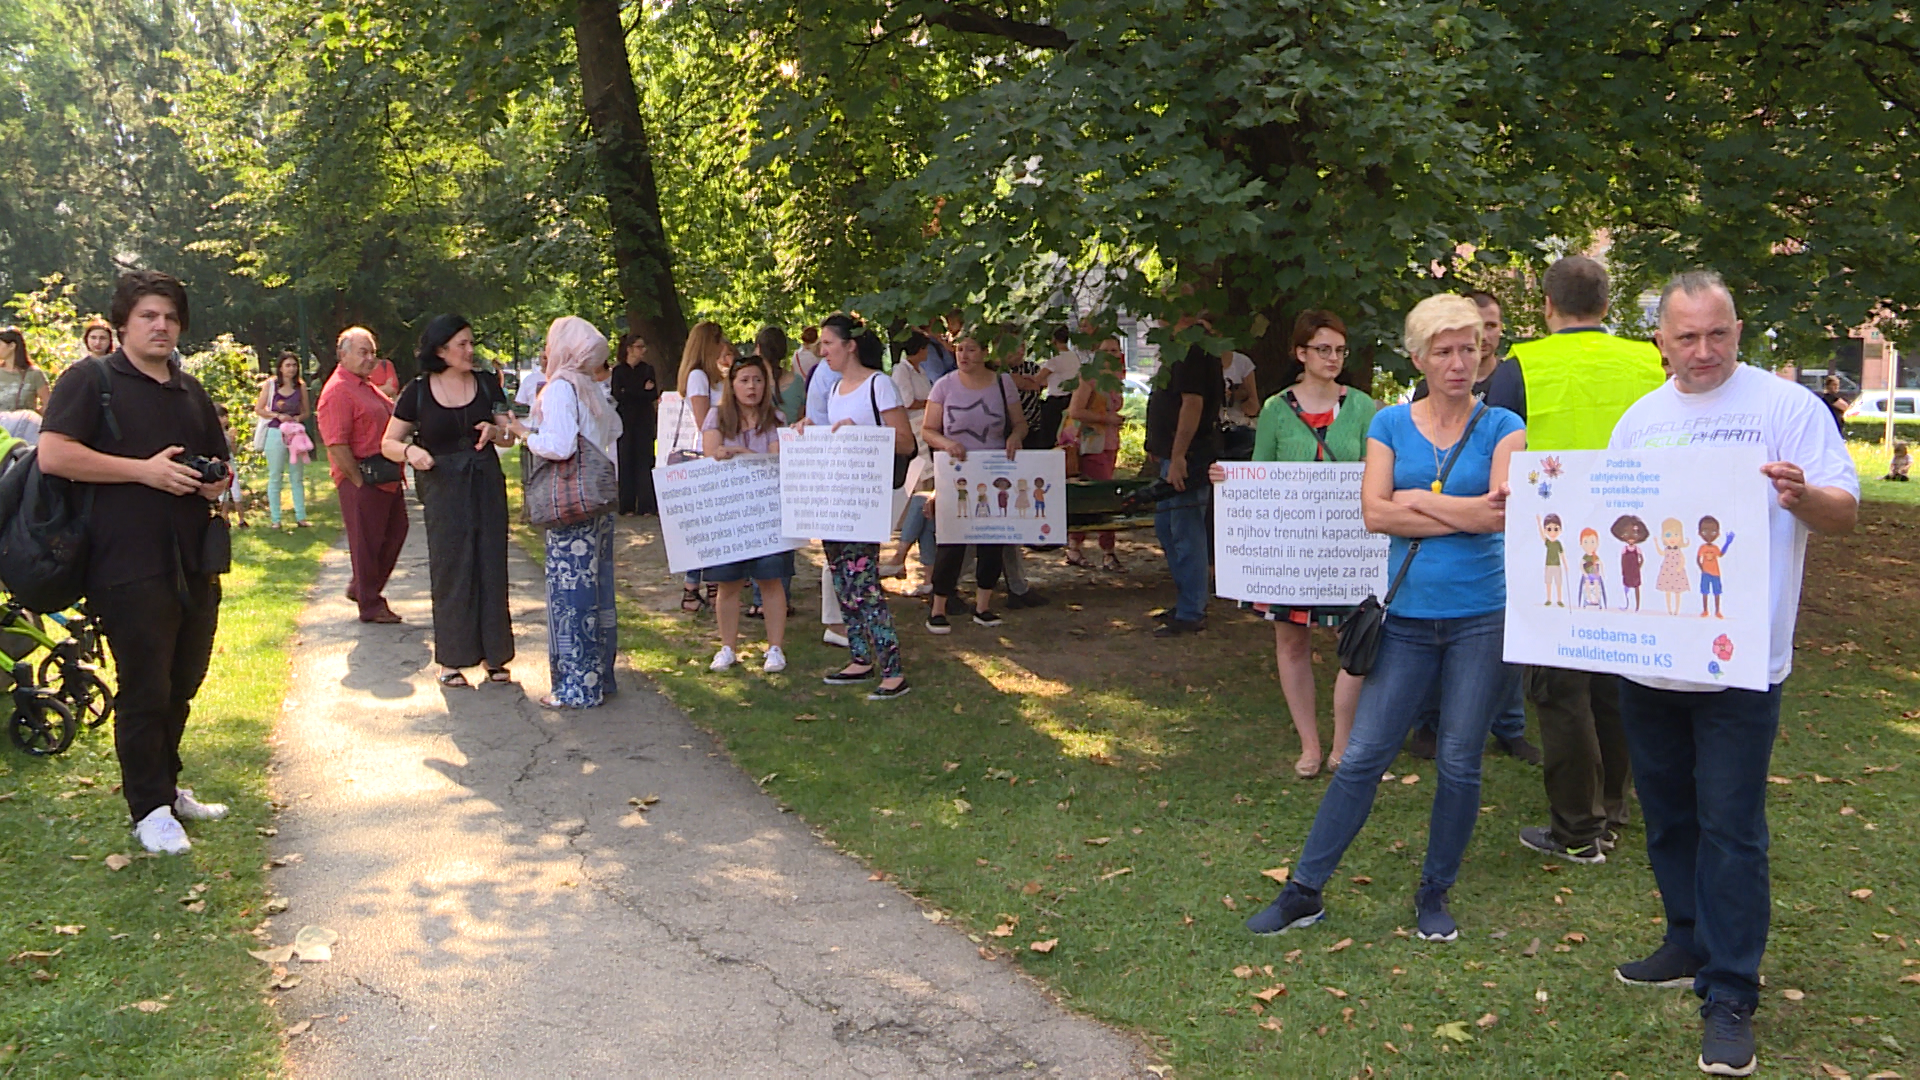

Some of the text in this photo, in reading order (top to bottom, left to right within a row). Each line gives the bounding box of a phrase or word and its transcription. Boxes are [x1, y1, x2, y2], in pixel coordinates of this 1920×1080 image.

[1606, 458, 1642, 469] Podrška
[1226, 466, 1267, 480] HITNO
[1269, 467, 1336, 484] obezbijediti
[1589, 471, 1661, 484] zahtjevima djece
[1221, 485, 1281, 502] kapacitete
[1284, 490, 1298, 500] za
[1606, 499, 1644, 510] u razvoju
[1255, 508, 1270, 520] sa
[1273, 506, 1316, 524] djecom
[1319, 506, 1322, 520] i
[1227, 526, 1234, 536] a
[1237, 525, 1271, 541] njihov
[1274, 526, 1318, 540] trenutni
[1225, 544, 1388, 562] nedostatni ili ne zadovoljava
[1242, 562, 1379, 582] minimalne uvjete za rad
[1246, 582, 1375, 600] odnodno smještaj istih
[1571, 625, 1656, 646] i osobama sa
[1558, 643, 1673, 668] invaliditetom u KS
